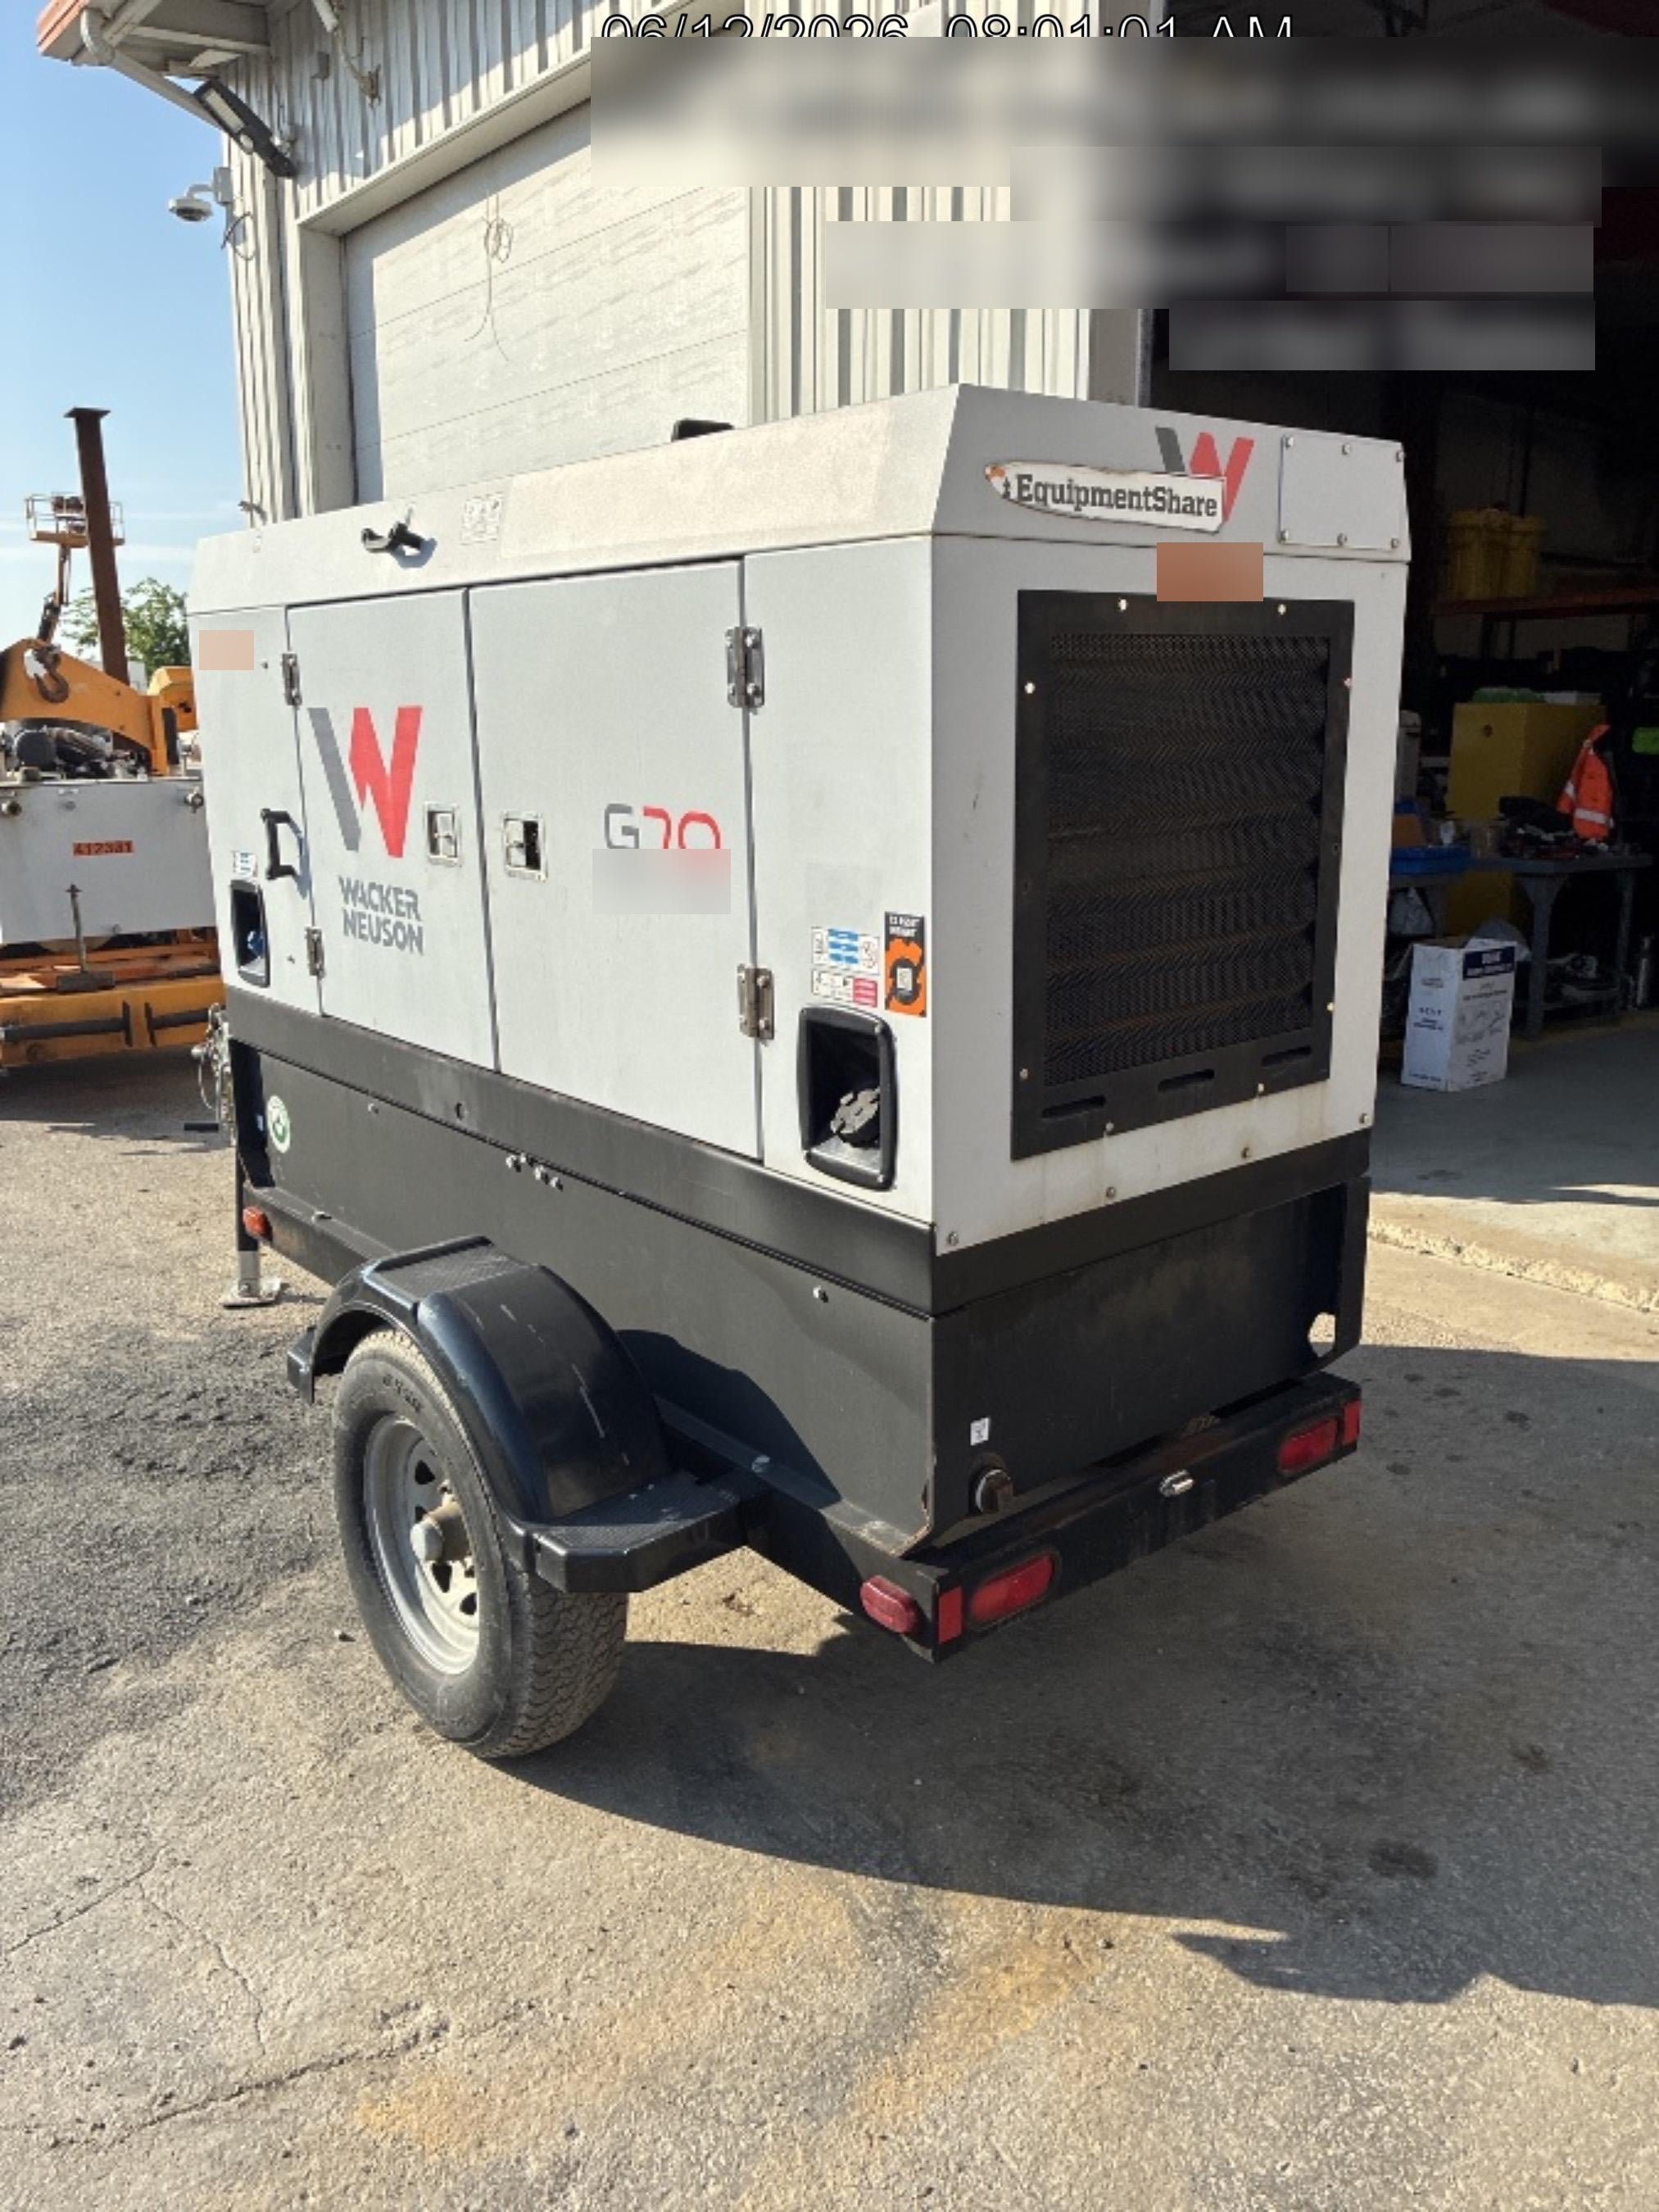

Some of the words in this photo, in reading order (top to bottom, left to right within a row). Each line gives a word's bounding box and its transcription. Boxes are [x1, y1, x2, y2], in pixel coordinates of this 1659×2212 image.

[1016, 474, 1217, 517] EquipmentShare
[604, 803, 721, 849] G70
[338, 874, 422, 922] WACKER
[342, 907, 424, 956] NEUSON
